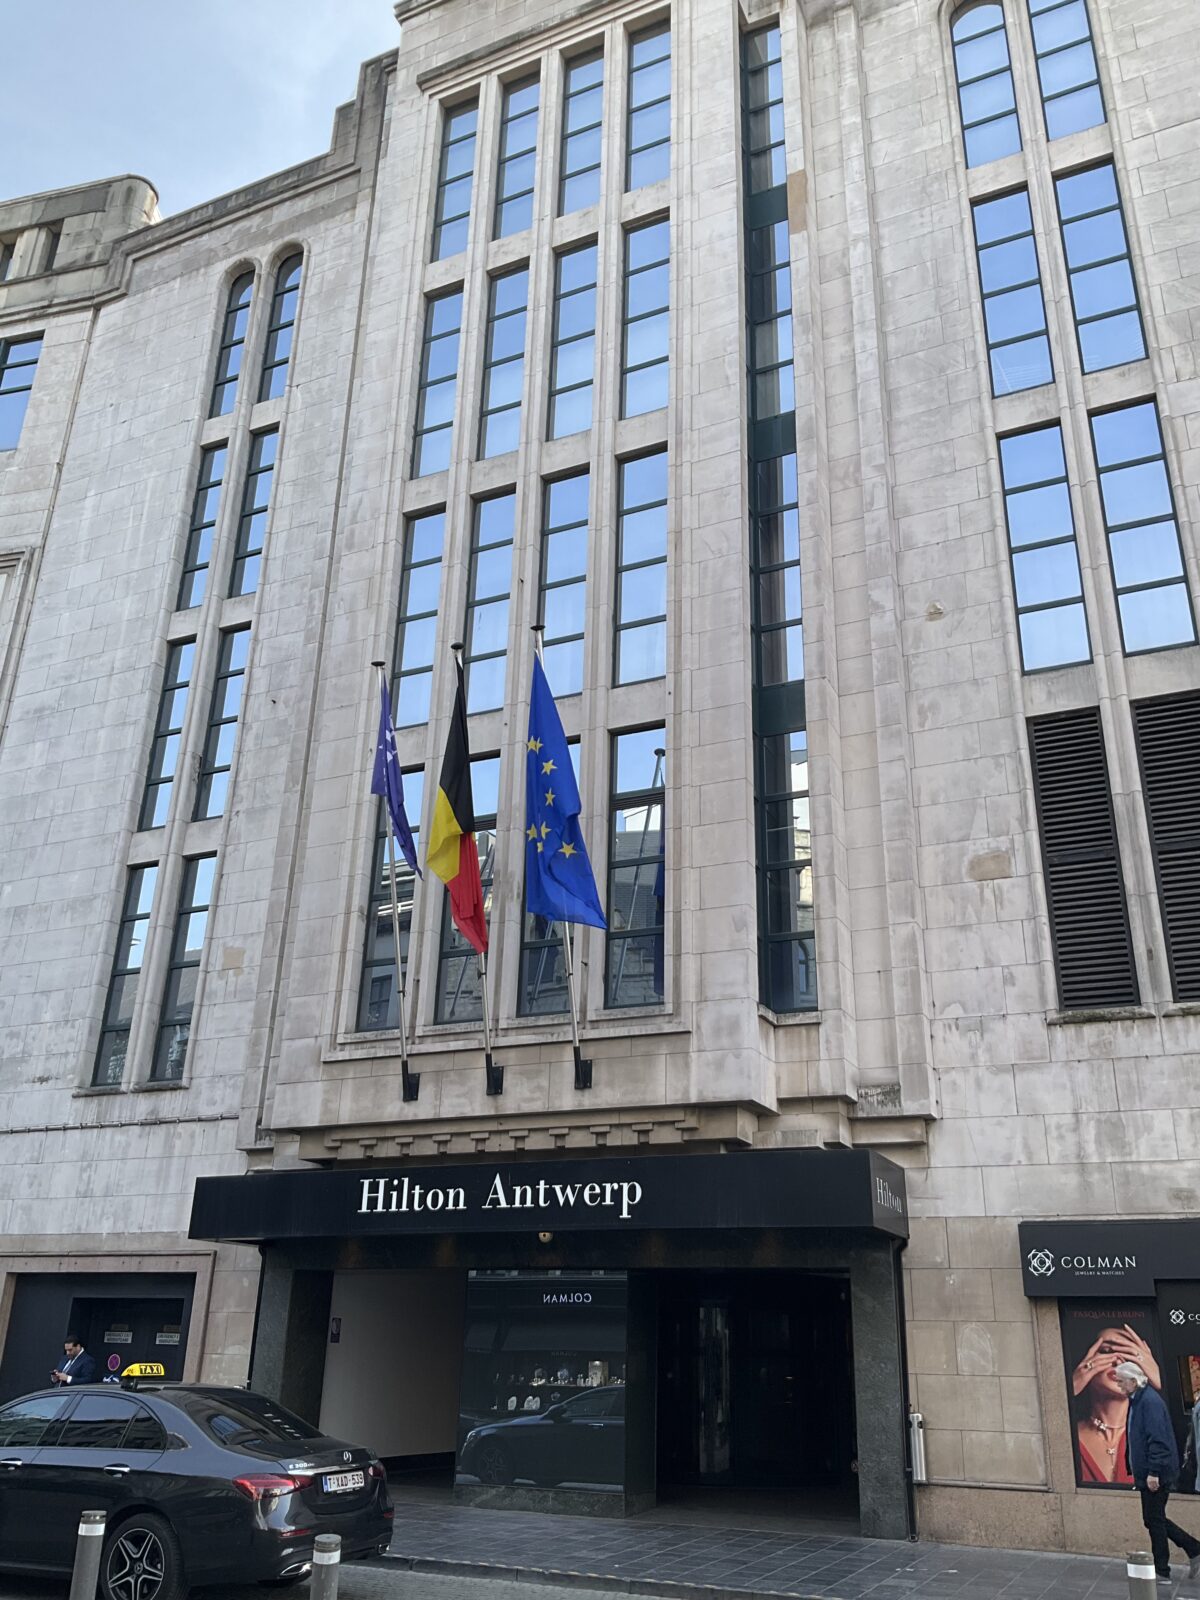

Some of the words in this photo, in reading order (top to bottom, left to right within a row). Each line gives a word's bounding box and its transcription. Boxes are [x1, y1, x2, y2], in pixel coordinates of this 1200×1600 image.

[357, 1177, 467, 1213] Hilton
[481, 1173, 643, 1218] Antwerp
[876, 1177, 902, 1213] Hilton
[1061, 1256, 1137, 1268] COLMAN
[140, 1365, 161, 1374] TAXI
